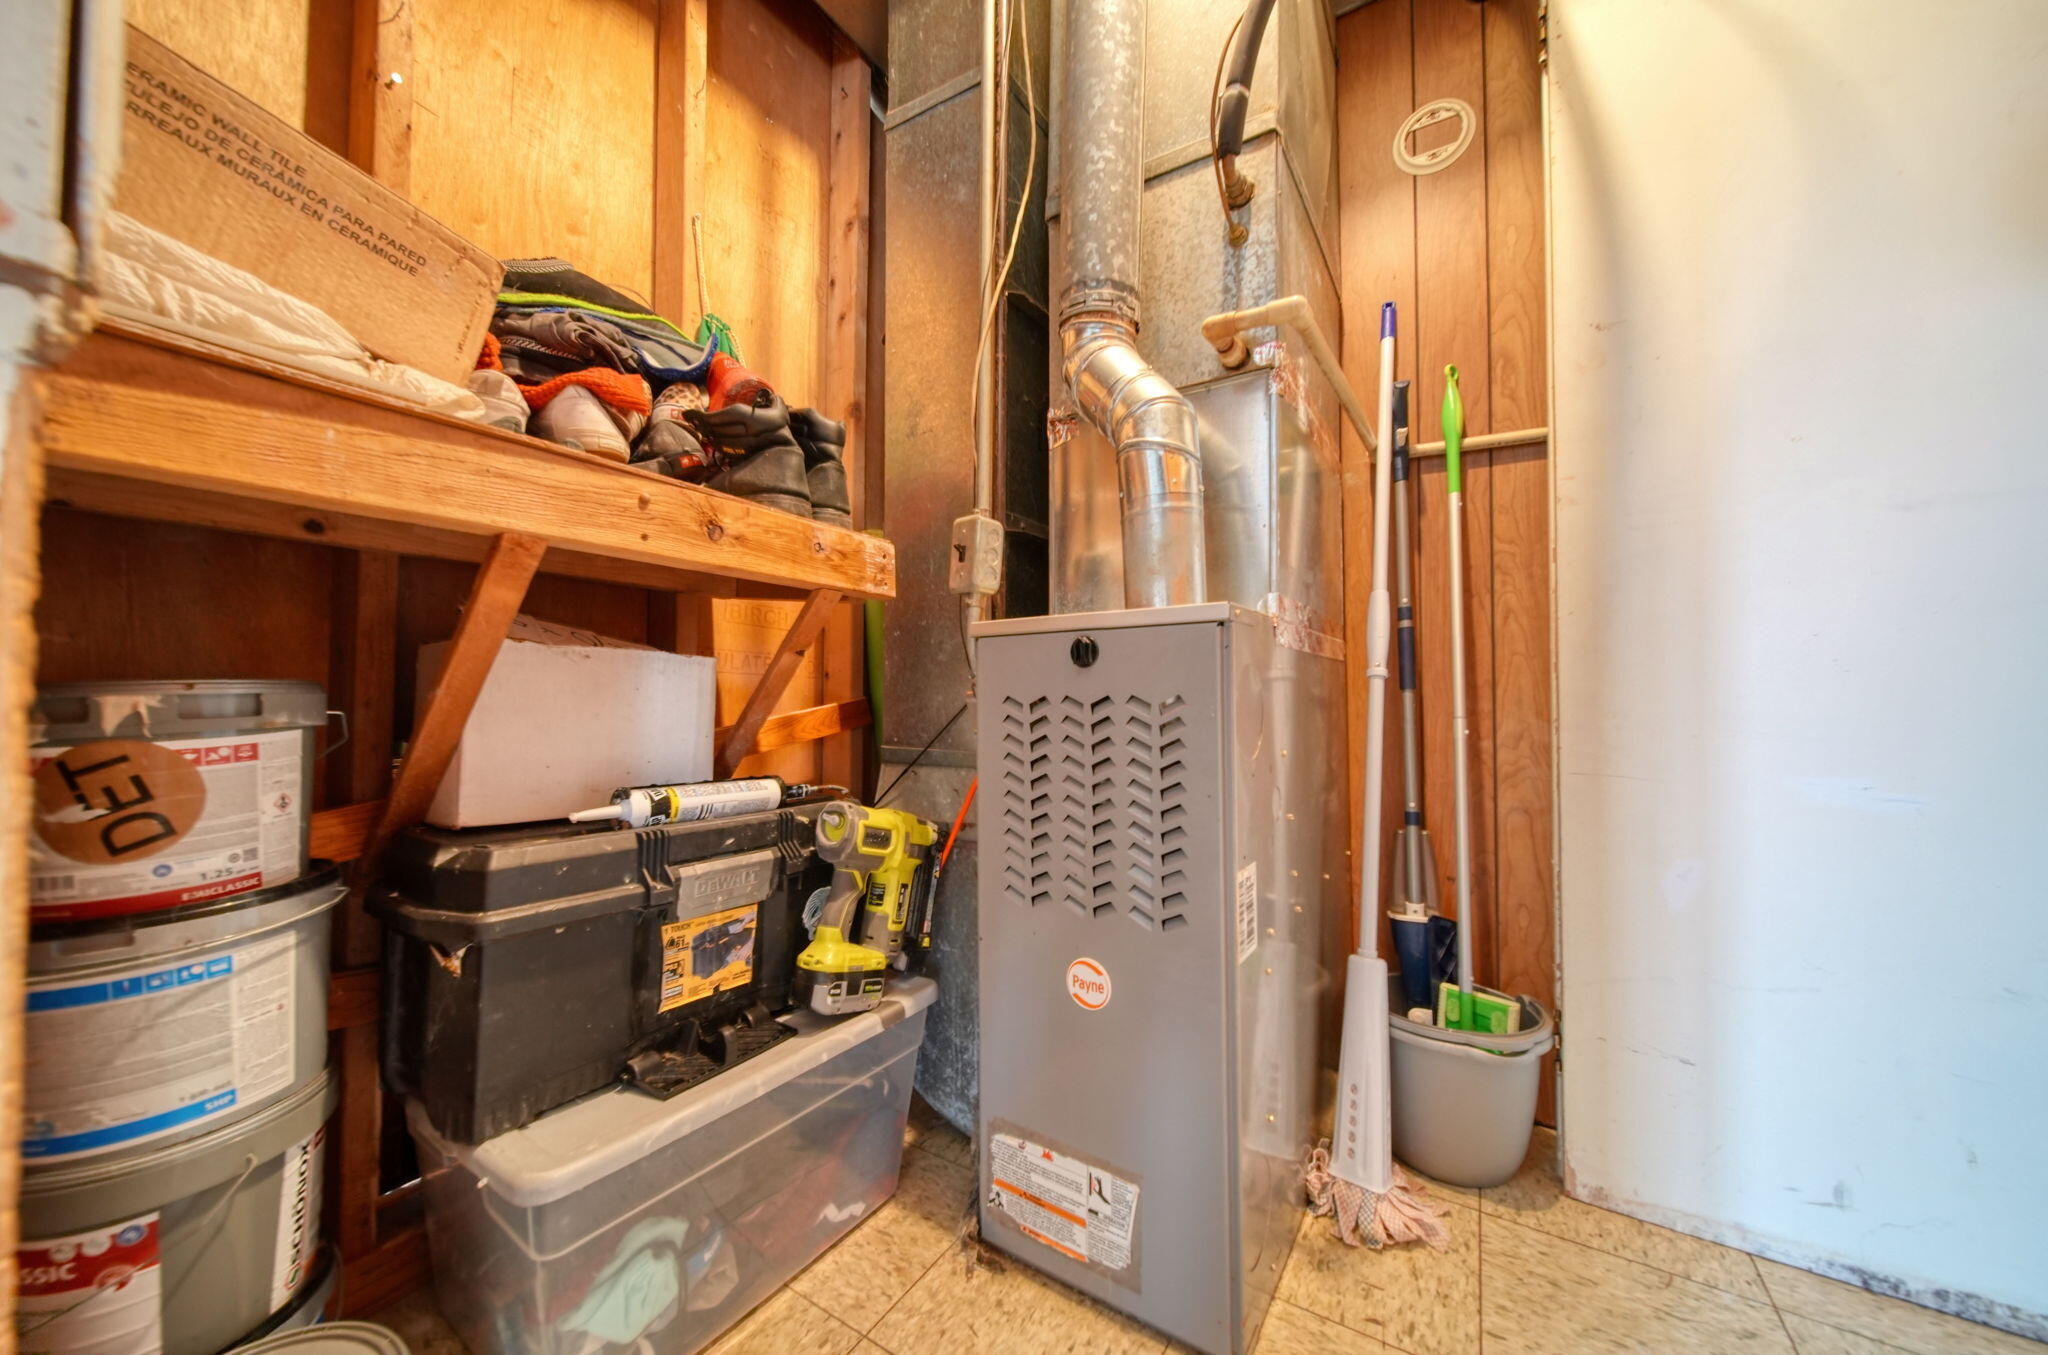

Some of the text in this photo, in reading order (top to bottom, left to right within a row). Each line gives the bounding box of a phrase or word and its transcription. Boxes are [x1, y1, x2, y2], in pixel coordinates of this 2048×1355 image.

[211, 113, 263, 152] WALL
[271, 149, 307, 178] TILE
[203, 128, 232, 151] DE
[333, 205, 374, 237] PARA
[378, 232, 426, 266] PARED
[216, 153, 297, 206] MURAUX
[301, 202, 324, 222] EN
[327, 219, 418, 277] CÉRAMIQUE
[1072, 974, 1105, 994] Payne
